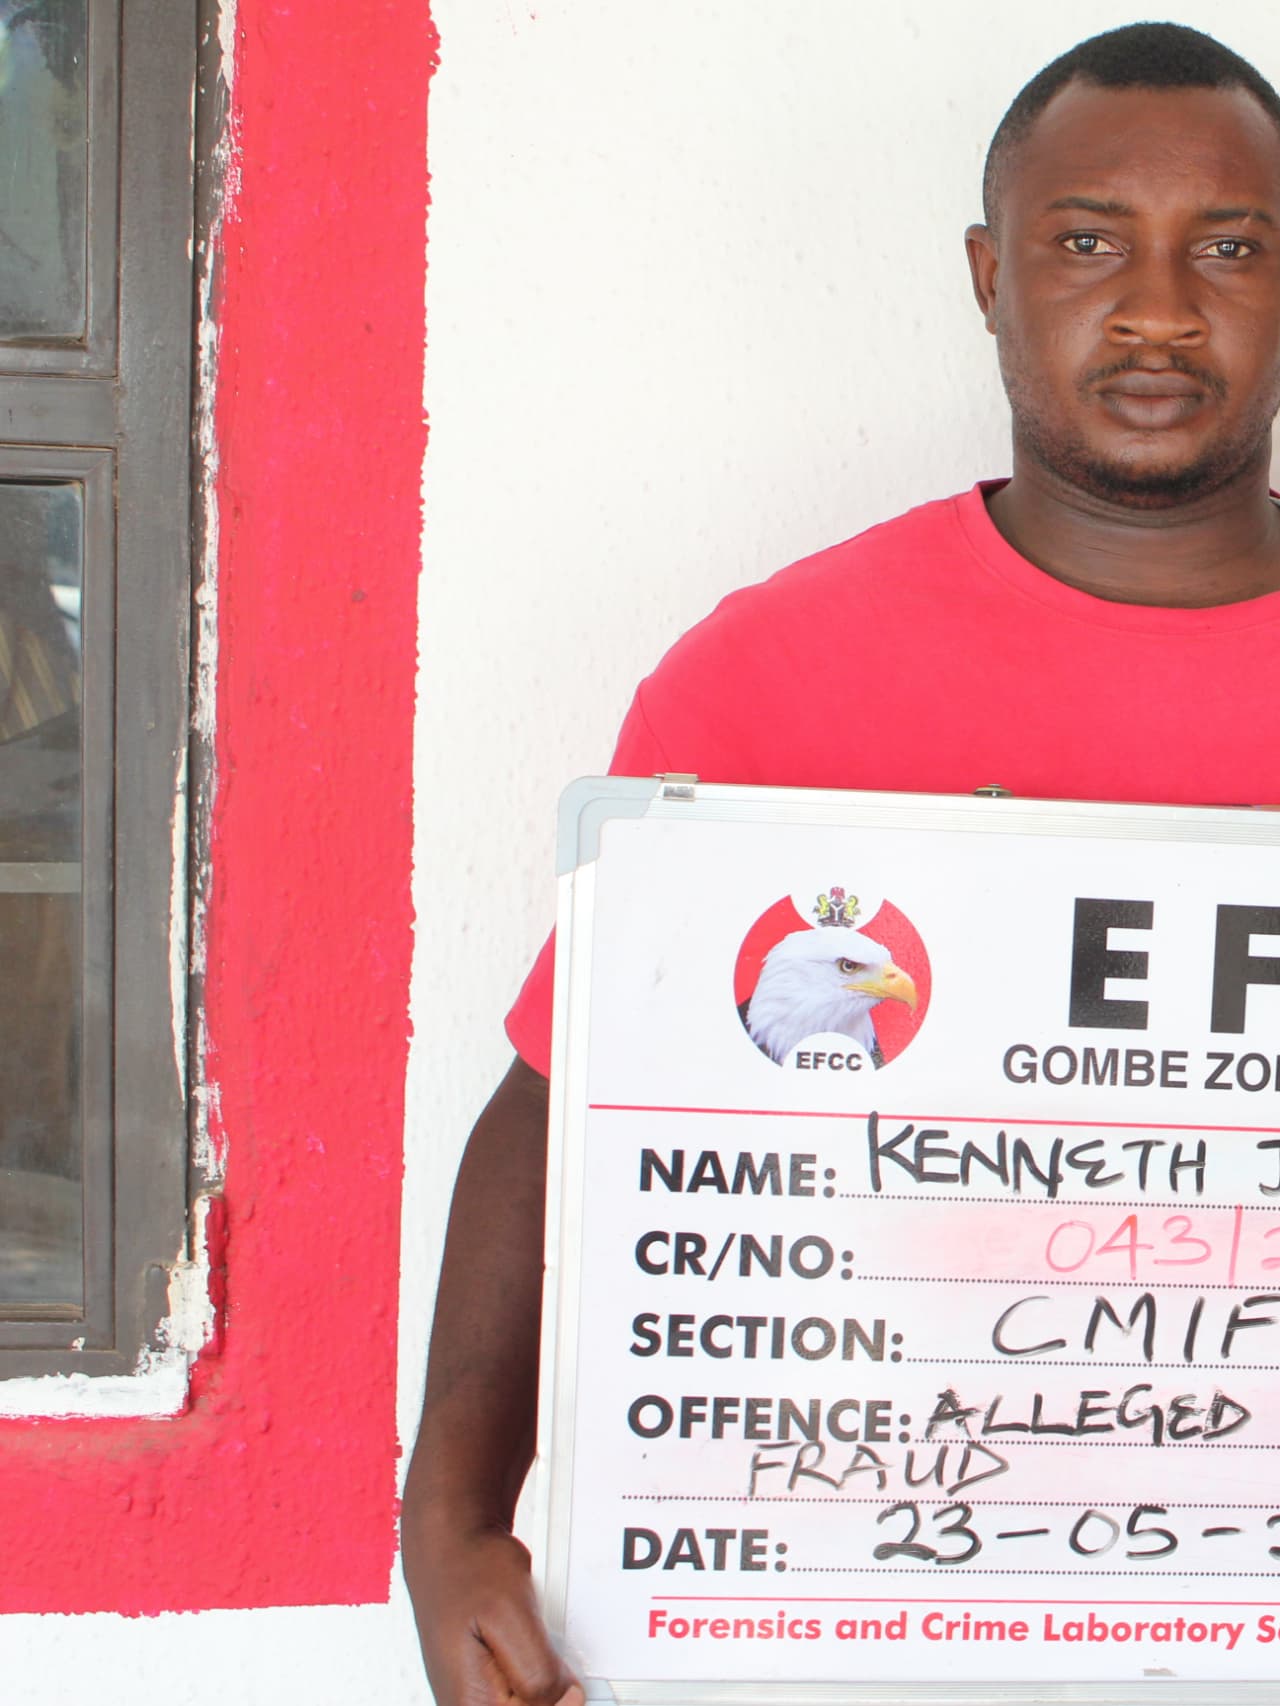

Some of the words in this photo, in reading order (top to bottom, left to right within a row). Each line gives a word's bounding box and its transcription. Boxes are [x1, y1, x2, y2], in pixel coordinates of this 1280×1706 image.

[795, 1050, 863, 1072] EFCC
[1002, 1044, 1188, 1090] GOMBE
[639, 1147, 837, 1199] NAME:
[866, 1110, 1207, 1199] KENNETH
[634, 1229, 855, 1281] CR/NO:
[629, 1311, 904, 1363] SECTION:
[627, 1394, 912, 1444] OFFENCE:
[924, 1383, 1252, 1446] ALLEGED
[748, 1440, 1009, 1498] FRAUD
[621, 1526, 788, 1573] DATE:
[647, 1608, 822, 1642] Forensics
[835, 1610, 907, 1642] and
[921, 1611, 1029, 1643] Crime
[1043, 1611, 1245, 1651] Laboratory
